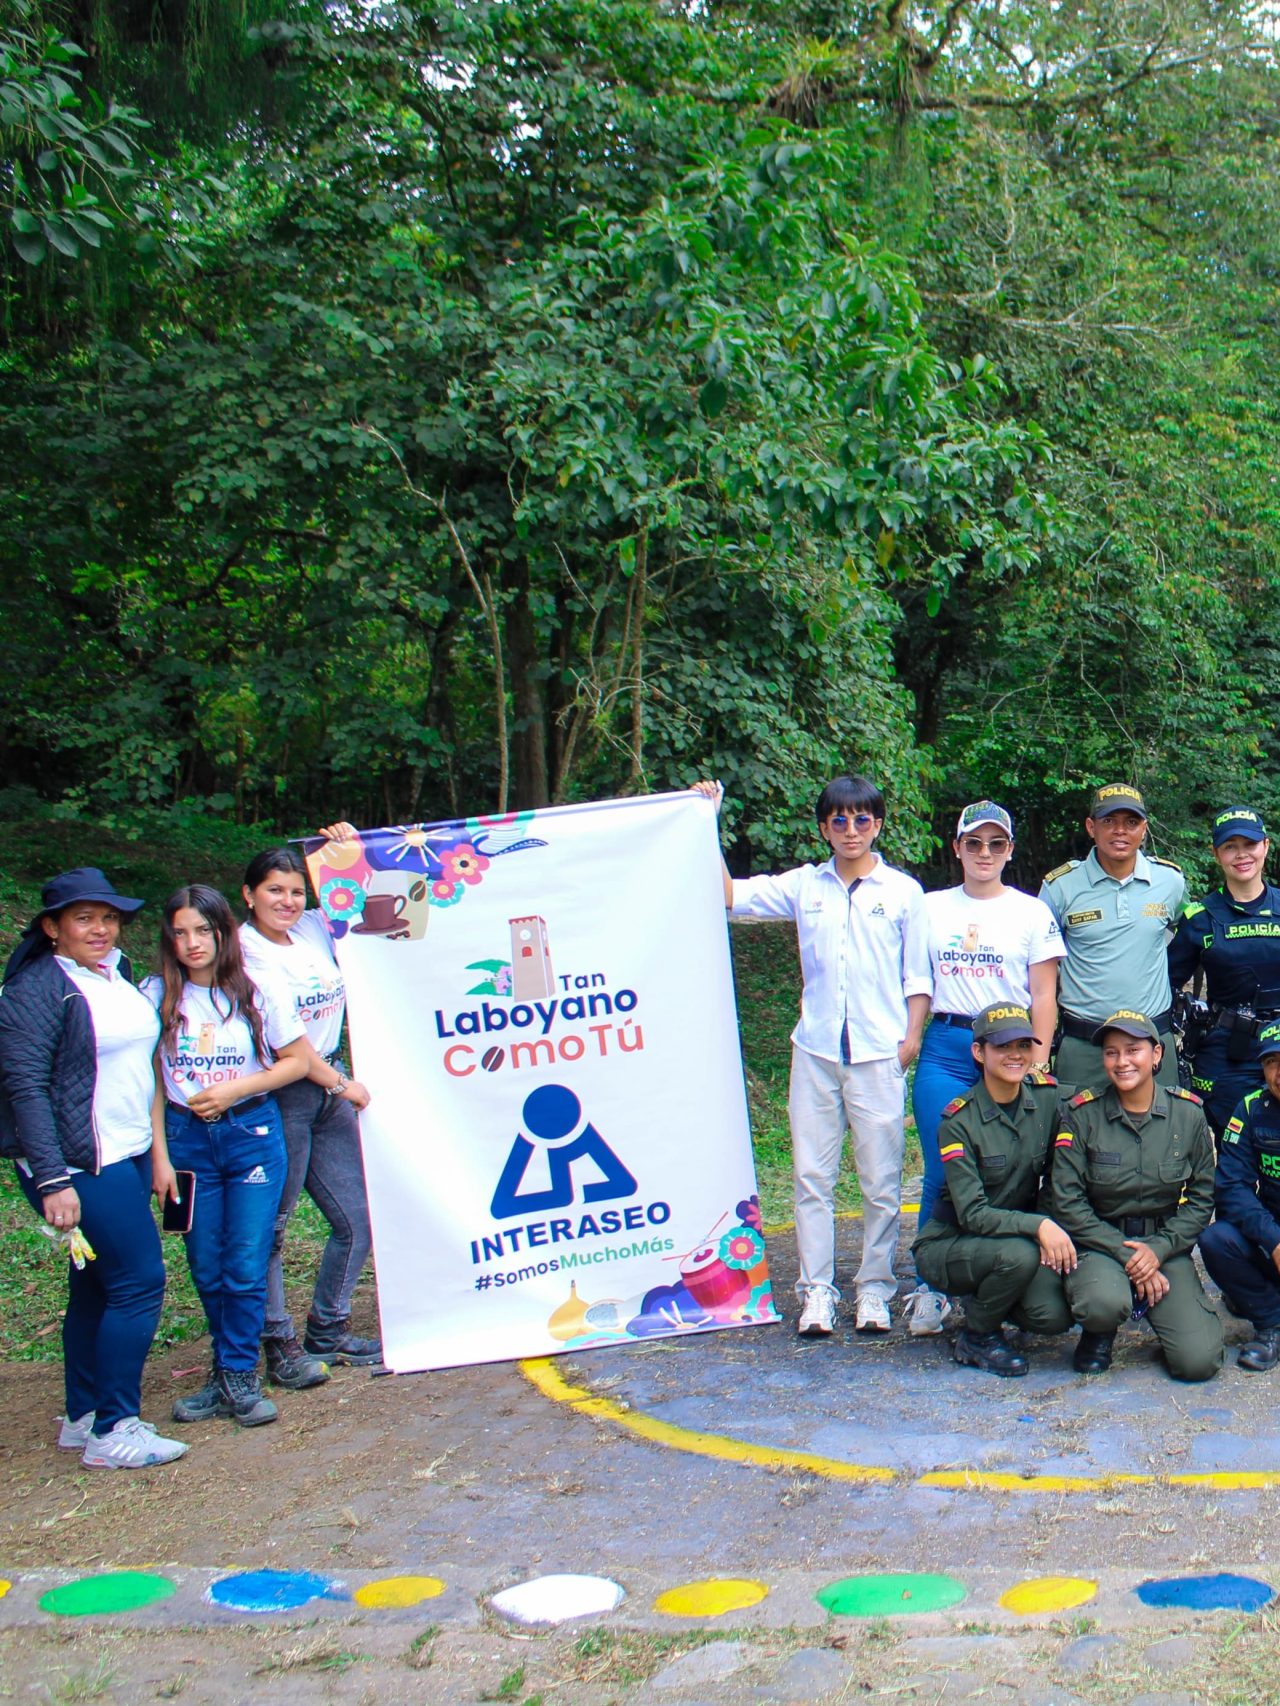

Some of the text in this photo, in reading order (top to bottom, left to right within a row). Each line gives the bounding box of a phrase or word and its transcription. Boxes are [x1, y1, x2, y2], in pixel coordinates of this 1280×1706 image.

[1100, 787, 1141, 802] POLICIA
[1216, 810, 1257, 827] POLICÍA
[937, 949, 1004, 966] Laboyano
[559, 972, 606, 992] Tan
[435, 989, 638, 1038] Laboyano
[216, 1046, 237, 1054] Tan
[443, 1018, 644, 1077] Como Tú
[167, 1053, 245, 1070] Laboyano
[470, 1201, 671, 1265] INTERASEO
[475, 1236, 675, 1291] #SomosMuchoMás
